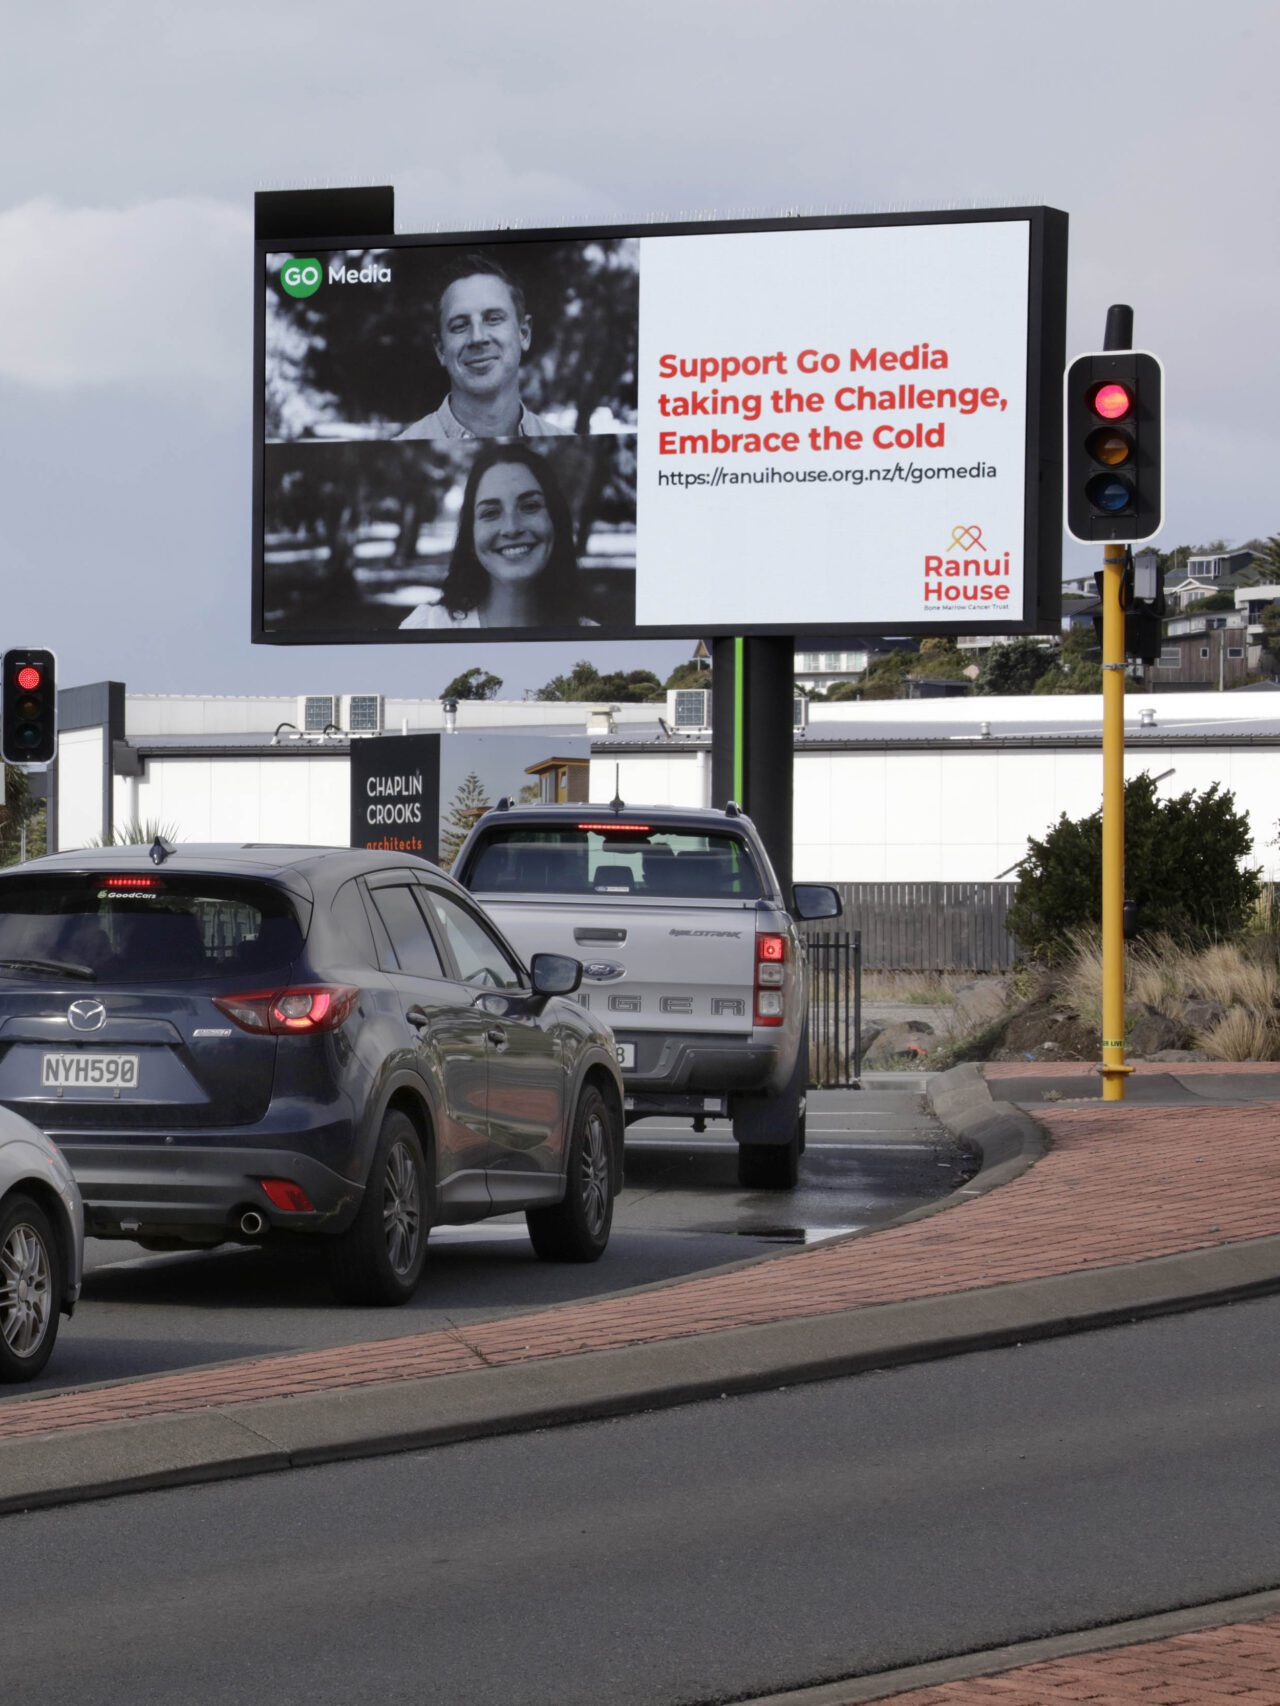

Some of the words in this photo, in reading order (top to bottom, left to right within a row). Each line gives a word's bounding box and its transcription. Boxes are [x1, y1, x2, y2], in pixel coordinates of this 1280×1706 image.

[284, 266, 319, 286] GO
[328, 264, 392, 285] Media
[659, 351, 788, 383] Support
[797, 349, 841, 374] Go
[850, 343, 949, 372] Media
[658, 388, 762, 421] taking
[770, 388, 825, 413] the
[834, 384, 1008, 415] Challenge,
[659, 428, 801, 455] Embrace
[808, 426, 864, 451] the
[872, 422, 945, 449] Cold
[658, 461, 997, 489] https://ranuihouse.org.nz/t/gomedia
[924, 551, 1010, 577] Ranui
[924, 581, 1010, 602] House
[366, 775, 423, 797] CHAPLIN
[366, 802, 422, 825] CROOKS
[366, 835, 424, 851] architects
[44, 1057, 135, 1084] NYH590
